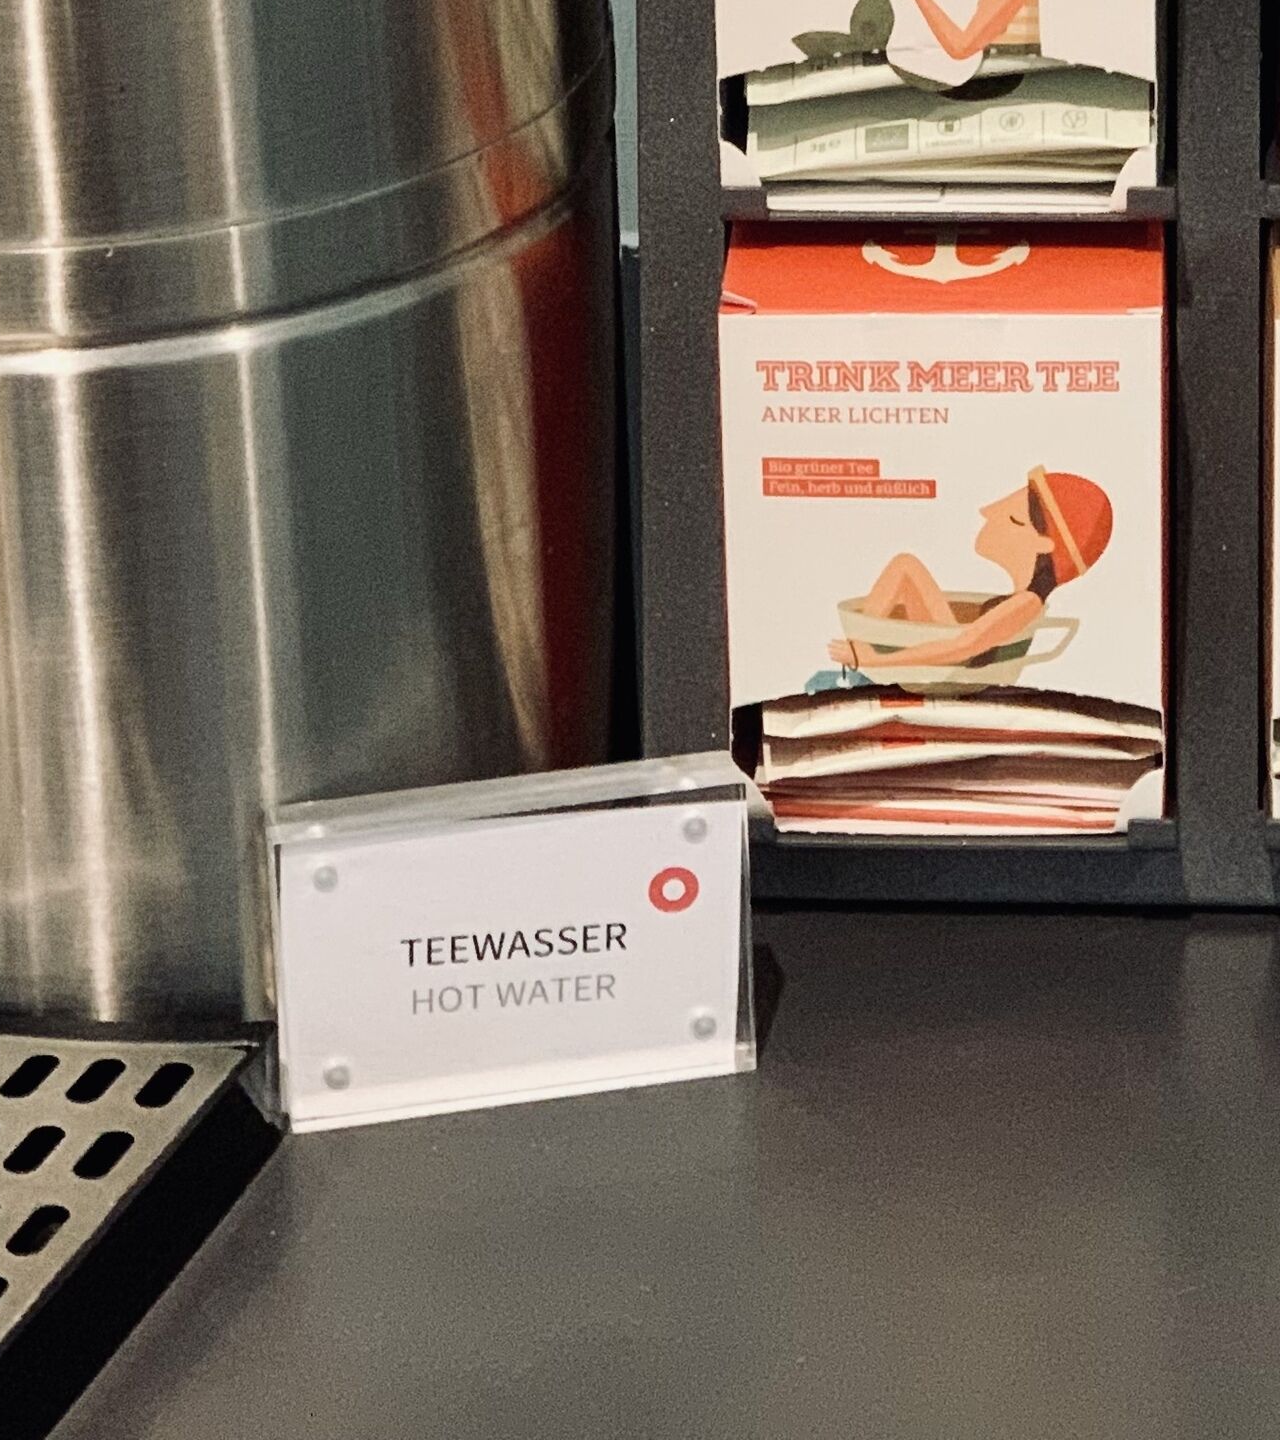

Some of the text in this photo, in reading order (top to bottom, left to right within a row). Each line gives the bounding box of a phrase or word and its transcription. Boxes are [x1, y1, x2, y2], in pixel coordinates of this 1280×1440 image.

[756, 361, 1120, 393] TRINK MEER TEE
[761, 406, 949, 425] ANKER LICHTEN
[769, 461, 874, 477] Bio grüner Tee
[769, 481, 930, 496] Fein, herb und süßlich
[401, 922, 627, 967] TEEWASSER
[412, 974, 616, 1015] HOT WATER
